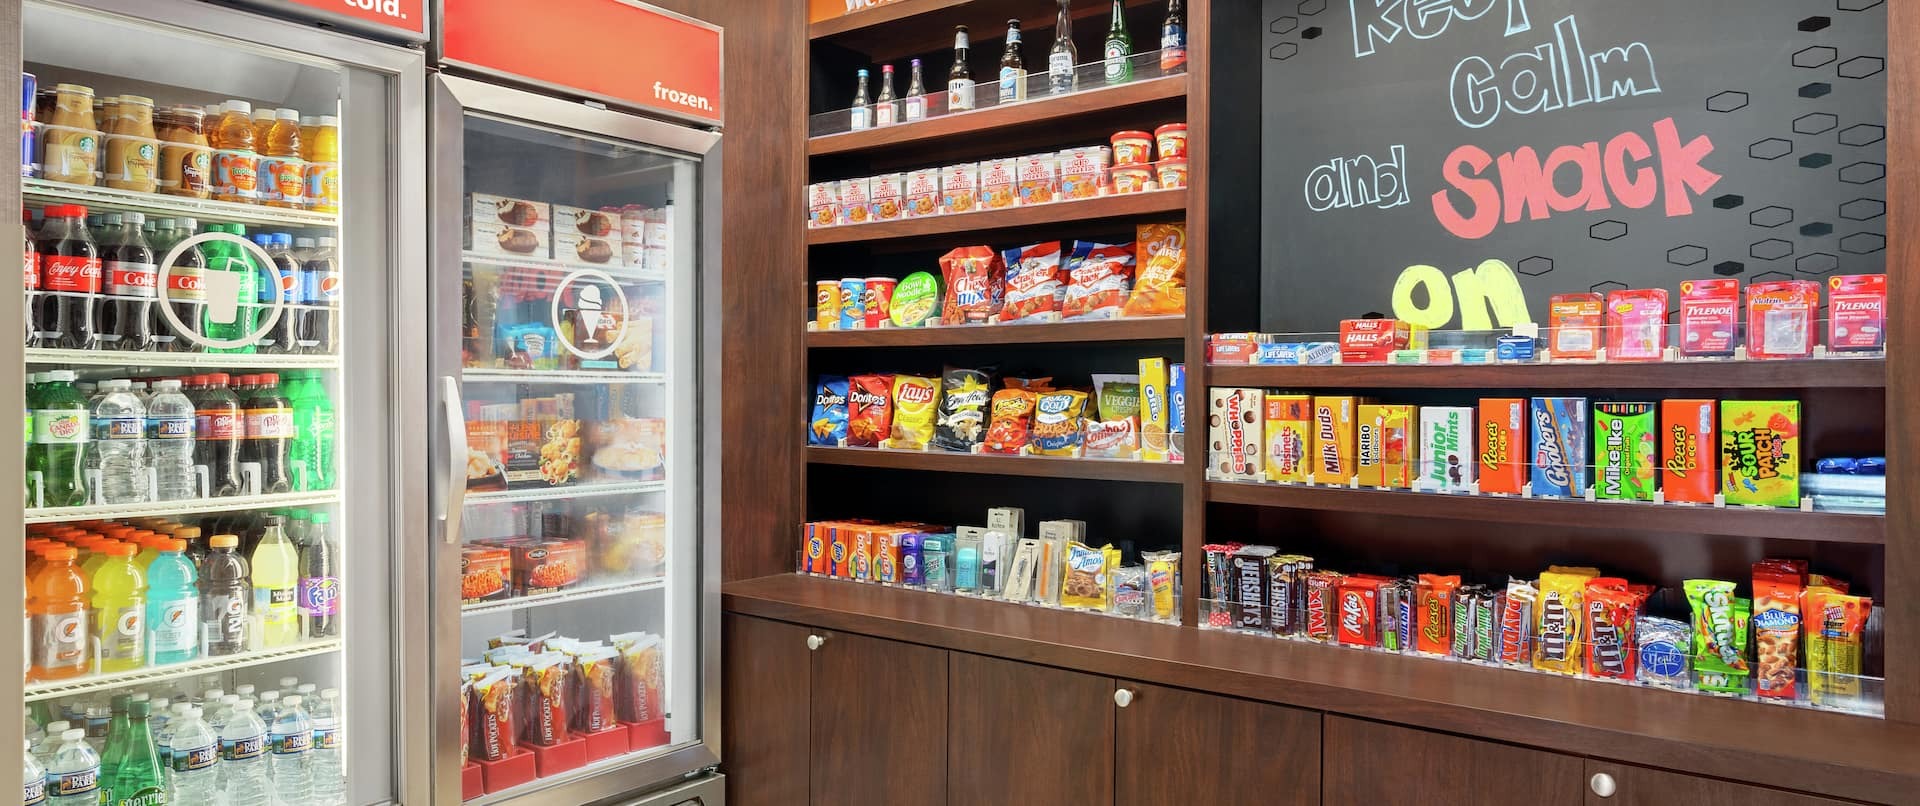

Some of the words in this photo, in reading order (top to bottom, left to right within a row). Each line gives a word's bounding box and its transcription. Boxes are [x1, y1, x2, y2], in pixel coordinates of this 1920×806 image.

[1350, 0, 1531, 57] Ke
[1450, 15, 1661, 128] calm
[652, 81, 713, 111] frozen.
[1305, 145, 1410, 211] and
[49, 261, 79, 276] Enjoy
[124, 272, 157, 287] Coke
[954, 275, 986, 293] Chex
[1392, 258, 1531, 330] on
[1687, 306, 1732, 316] TYLENOL
[1835, 301, 1880, 311] TYLENOL
[1346, 333, 1378, 343] HALLS
[816, 394, 846, 406] Doritos
[850, 392, 886, 407] Doritos
[1145, 385, 1159, 421] OREO
[1319, 406, 1335, 441] Duds
[1446, 411, 1459, 452] Mints
[1281, 425, 1292, 475] Raisinets
[1324, 443, 1341, 474] Milk
[1360, 425, 1371, 467] HARIBO
[1430, 422, 1447, 487] Junior
[1482, 421, 1499, 470] Reese's
[1536, 408, 1570, 487] Goobers
[1666, 424, 1687, 478] Reese's
[1737, 430, 1757, 478] SOUR
[1755, 427, 1780, 480] PATCH
[1208, 551, 1216, 573] KIND
[308, 584, 337, 608] Fan
[1242, 561, 1262, 626] HERSHEY'S
[1271, 572, 1286, 627] HERSHEY'S
[1308, 588, 1328, 637] TWIX
[1501, 598, 1523, 663] PAYDAY
[1754, 615, 1799, 627] DIAMOND
[1763, 611, 1787, 621] BLUE
